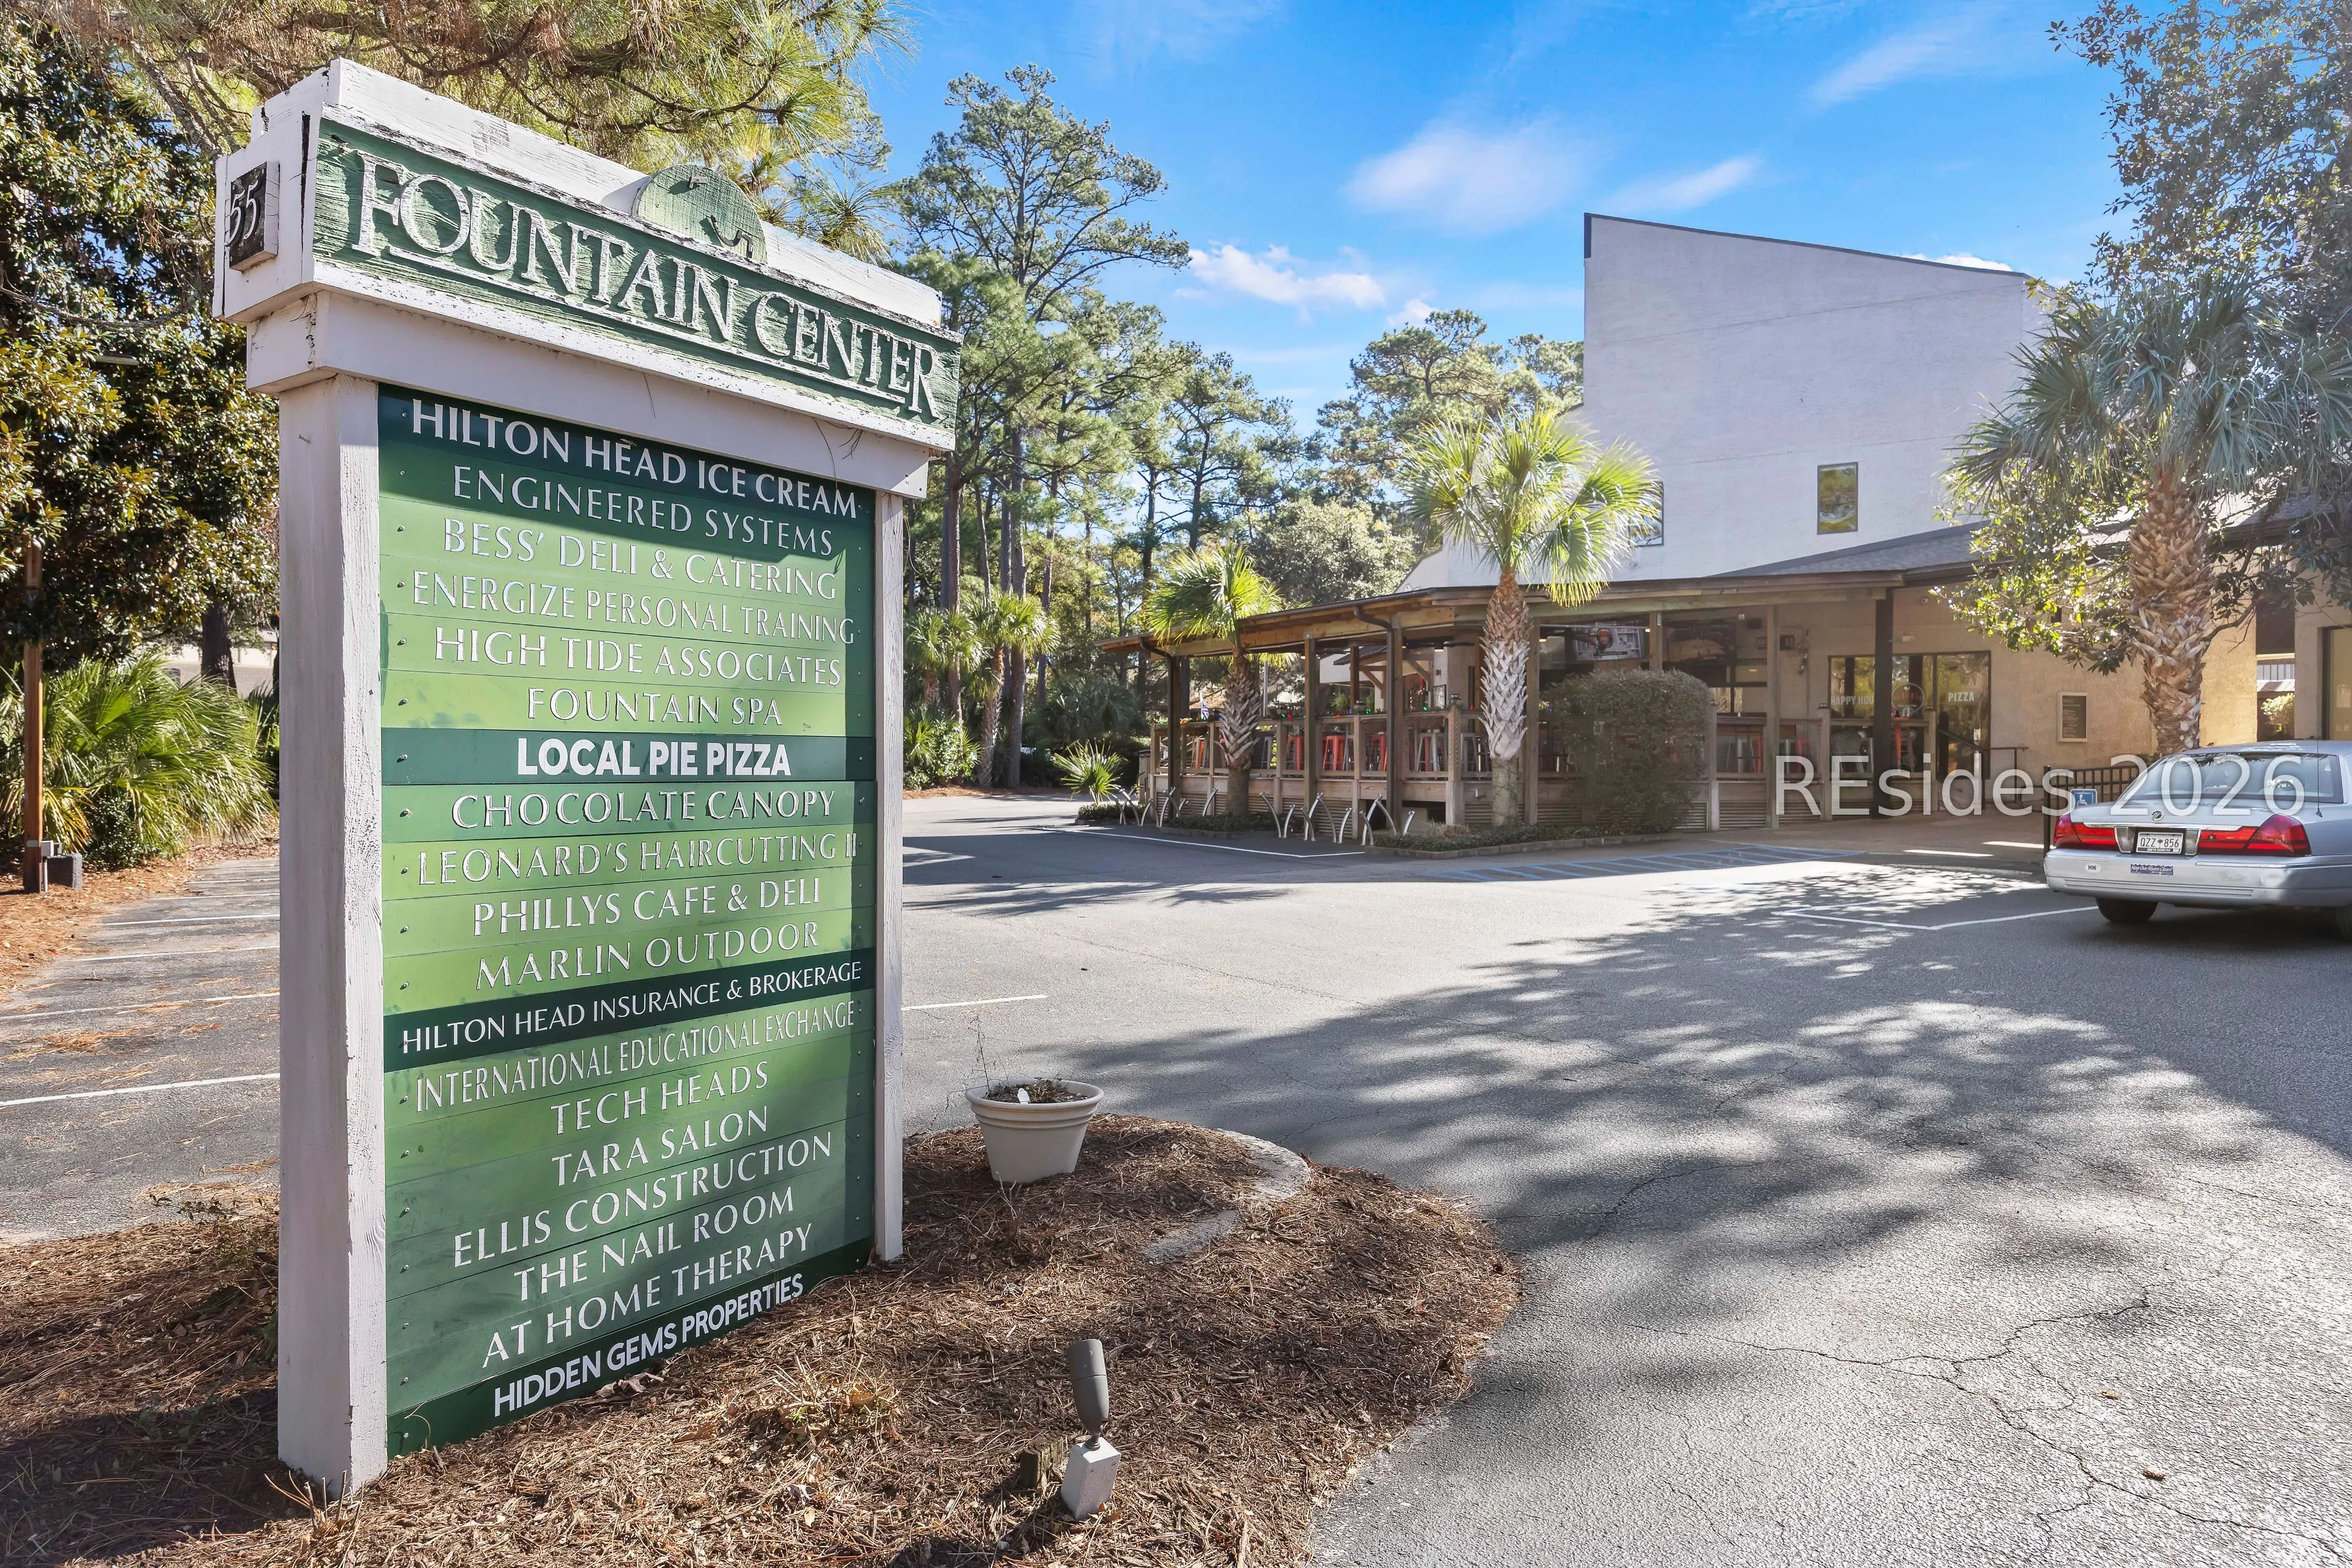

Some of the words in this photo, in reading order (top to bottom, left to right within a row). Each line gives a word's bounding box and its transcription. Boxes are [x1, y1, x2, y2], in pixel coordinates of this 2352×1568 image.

[224, 180, 258, 246] 55
[353, 148, 736, 341] FOUNTAIN
[755, 288, 940, 420] CENTER
[412, 399, 568, 463] HILTON
[585, 437, 686, 483] HEAD
[699, 461, 745, 497] ICE
[756, 474, 856, 518] CREAM
[454, 466, 692, 532] ENGINEERED
[706, 509, 832, 556] SYSTEMS
[560, 535, 636, 575] DELI
[651, 549, 674, 579] &
[685, 554, 837, 600] CATERING
[413, 571, 575, 617] ENERGIZE
[587, 590, 732, 634] PERSONAL
[741, 606, 854, 644] TRAINING
[435, 627, 546, 667] HIGH
[561, 638, 643, 673] TIDE
[655, 646, 840, 686] ASSOCIATES
[528, 687, 719, 724] FOUNTAIN
[731, 696, 782, 725] SPA
[1831, 695, 1855, 706] HAPPY
[1858, 695, 1874, 705] HOU
[1948, 692, 1974, 702] PIZZA
[518, 738, 640, 776] LOCAL
[649, 741, 698, 775] PIE
[706, 742, 791, 776] PIZZA
[452, 790, 695, 829] CHOCOLATE
[705, 790, 835, 819] CANOPY
[418, 843, 628, 886] LEONARD'S
[641, 834, 835, 870] HAIRCUTTING
[846, 832, 857, 858] II
[473, 892, 620, 936] PHILLYS
[633, 885, 716, 920] CAFE
[727, 883, 747, 911] &
[760, 878, 820, 908] DELI
[477, 942, 631, 990] MARLIN
[646, 922, 818, 967] OUTDOOR
[403, 1017, 505, 1054] HILTON
[515, 1004, 584, 1035] HEAD
[594, 983, 720, 1021] INSURANCE
[727, 980, 742, 999] &
[749, 962, 860, 995] BROKERAGE
[417, 1038, 612, 1112] INTERNATIONAL
[619, 1019, 758, 1072] EDUCATIONAL
[766, 1001, 854, 1046] EXCHANGE
[551, 1087, 646, 1134] TECH
[662, 1061, 769, 1110] HEADS
[552, 1137, 649, 1186] TARA
[662, 1106, 767, 1160] SALON
[454, 1210, 551, 1267] ELLIS
[565, 1132, 832, 1232] CONSTRUCTION
[514, 1250, 589, 1302] THE
[602, 1223, 680, 1273] NAIL
[694, 1187, 793, 1243] ROOM
[483, 1320, 532, 1368] AT
[547, 1276, 660, 1343] HOME
[672, 1223, 812, 1296] THERAPY
[494, 1351, 601, 1417] HIDDEN
[606, 1323, 676, 1371] GEMS
[682, 1273, 803, 1343] PROPERTIES
